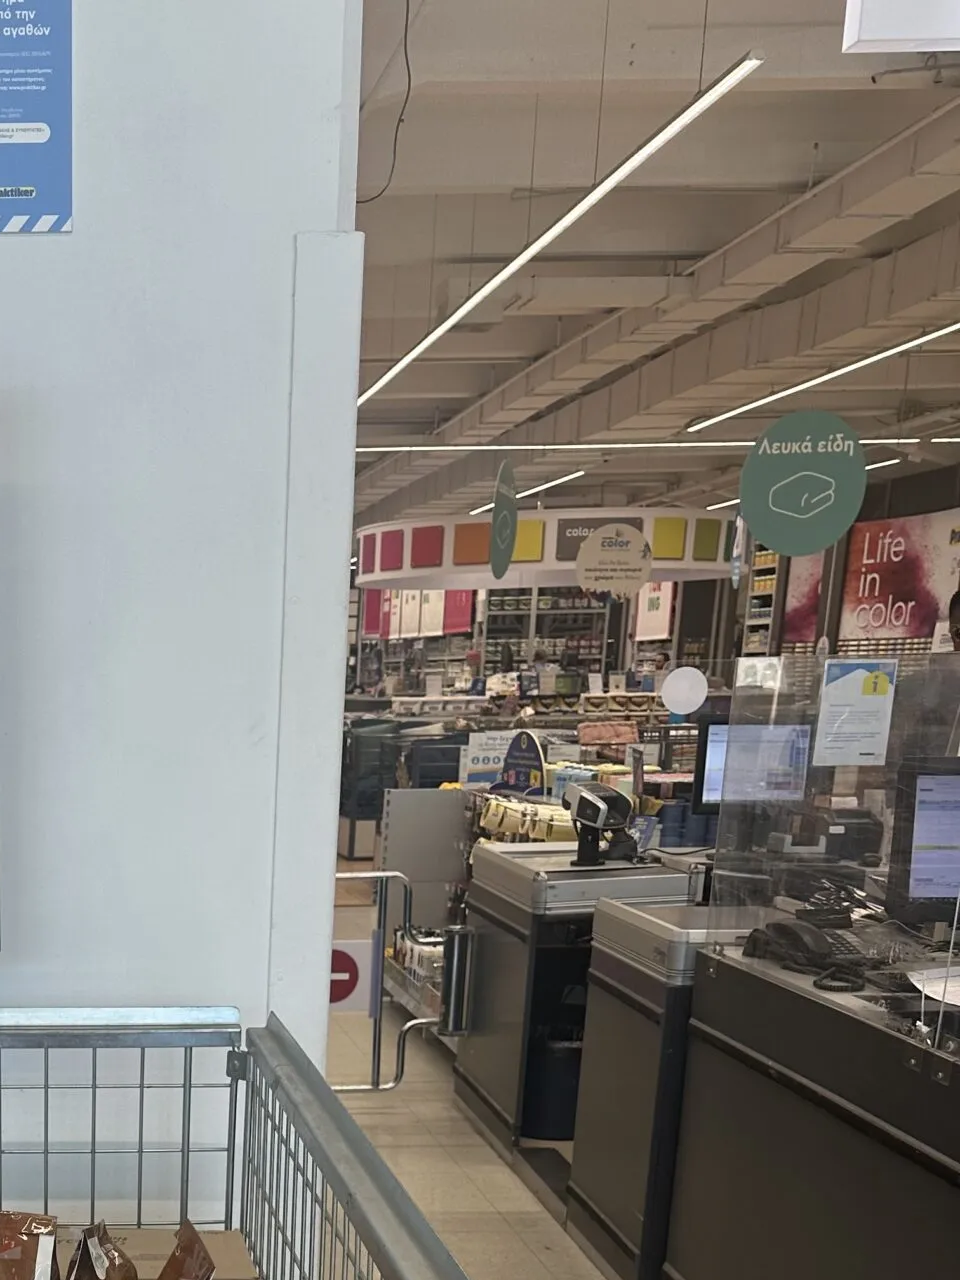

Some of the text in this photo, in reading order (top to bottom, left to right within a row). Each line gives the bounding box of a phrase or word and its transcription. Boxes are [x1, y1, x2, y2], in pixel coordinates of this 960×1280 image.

[15, 10, 36, 22] την
[3, 23, 52, 38] αγαθών
[759, 433, 855, 457] Λευκά είδη
[565, 527, 594, 537] color
[601, 539, 631, 549] color
[862, 530, 906, 565] Life
[858, 567, 881, 598] in
[854, 594, 916, 629] color
